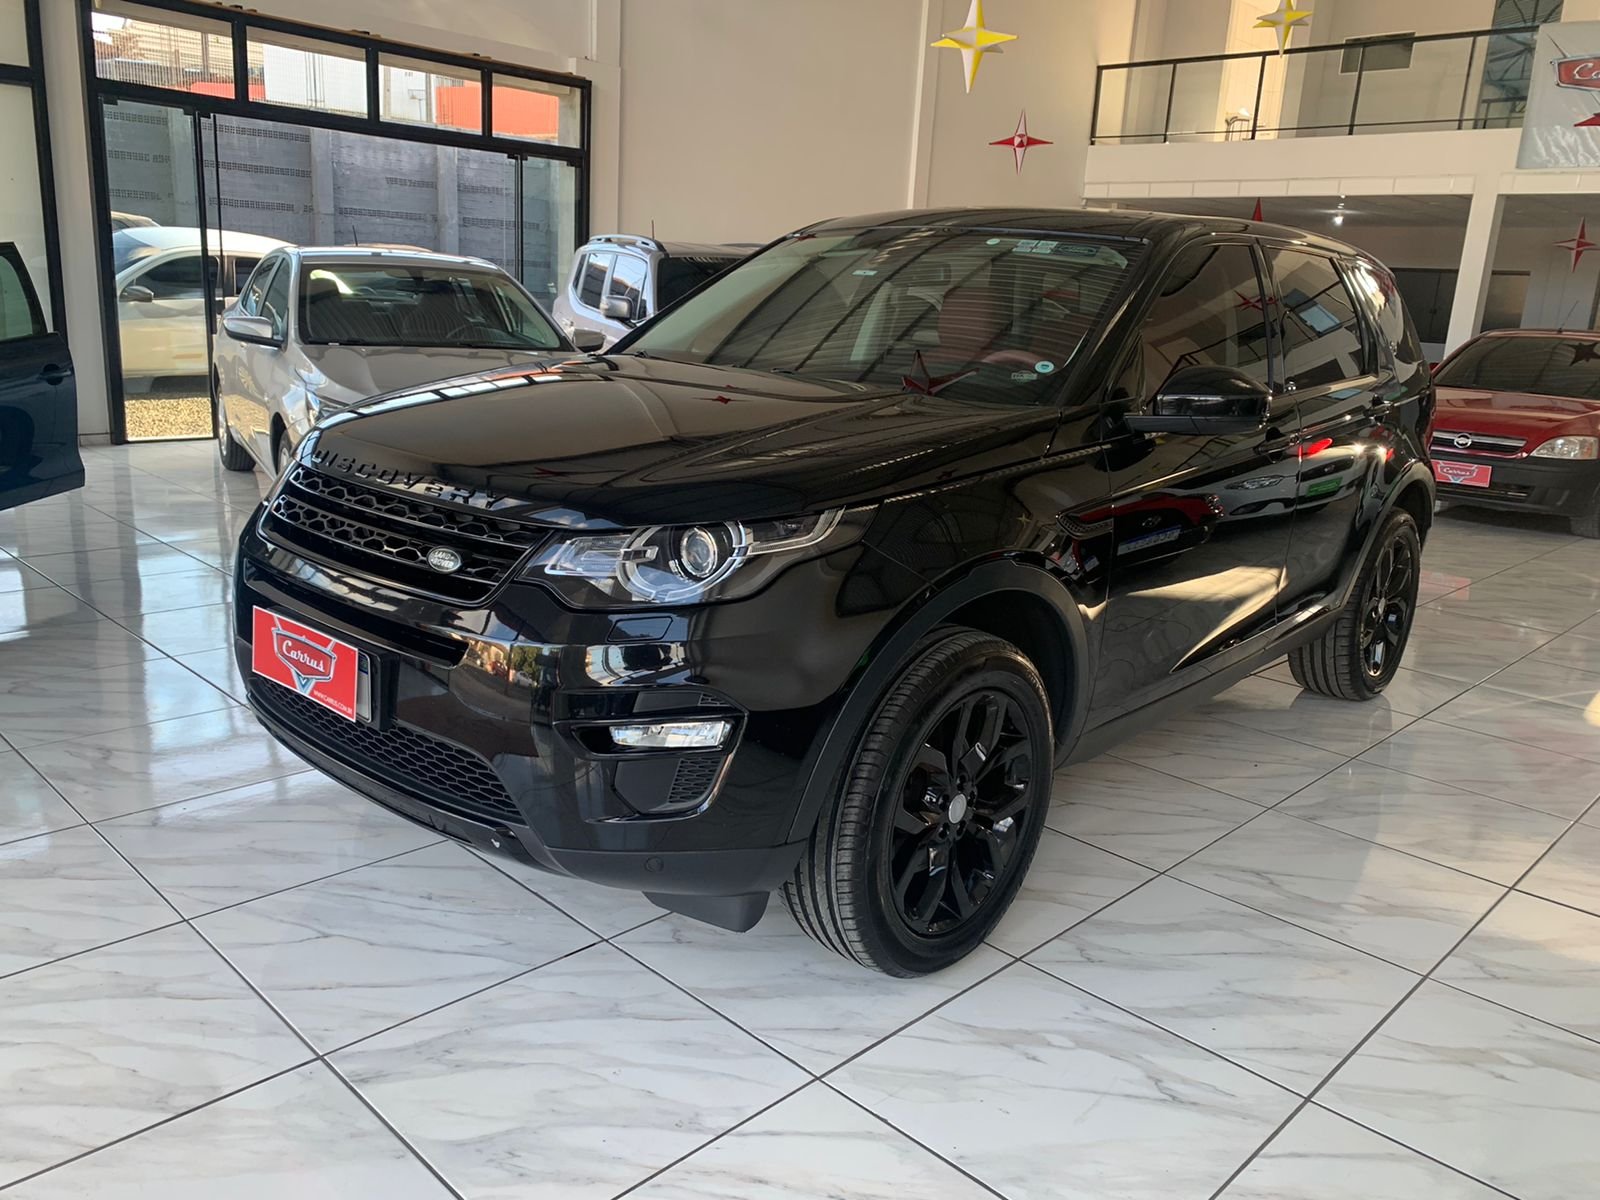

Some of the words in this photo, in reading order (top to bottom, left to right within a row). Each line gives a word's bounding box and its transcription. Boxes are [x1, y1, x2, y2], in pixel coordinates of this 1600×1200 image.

[312, 449, 510, 509] DISCOVERY
[433, 558, 455, 569] ROVER
[434, 550, 452, 560] LAND
[282, 640, 325, 673] Carrus
